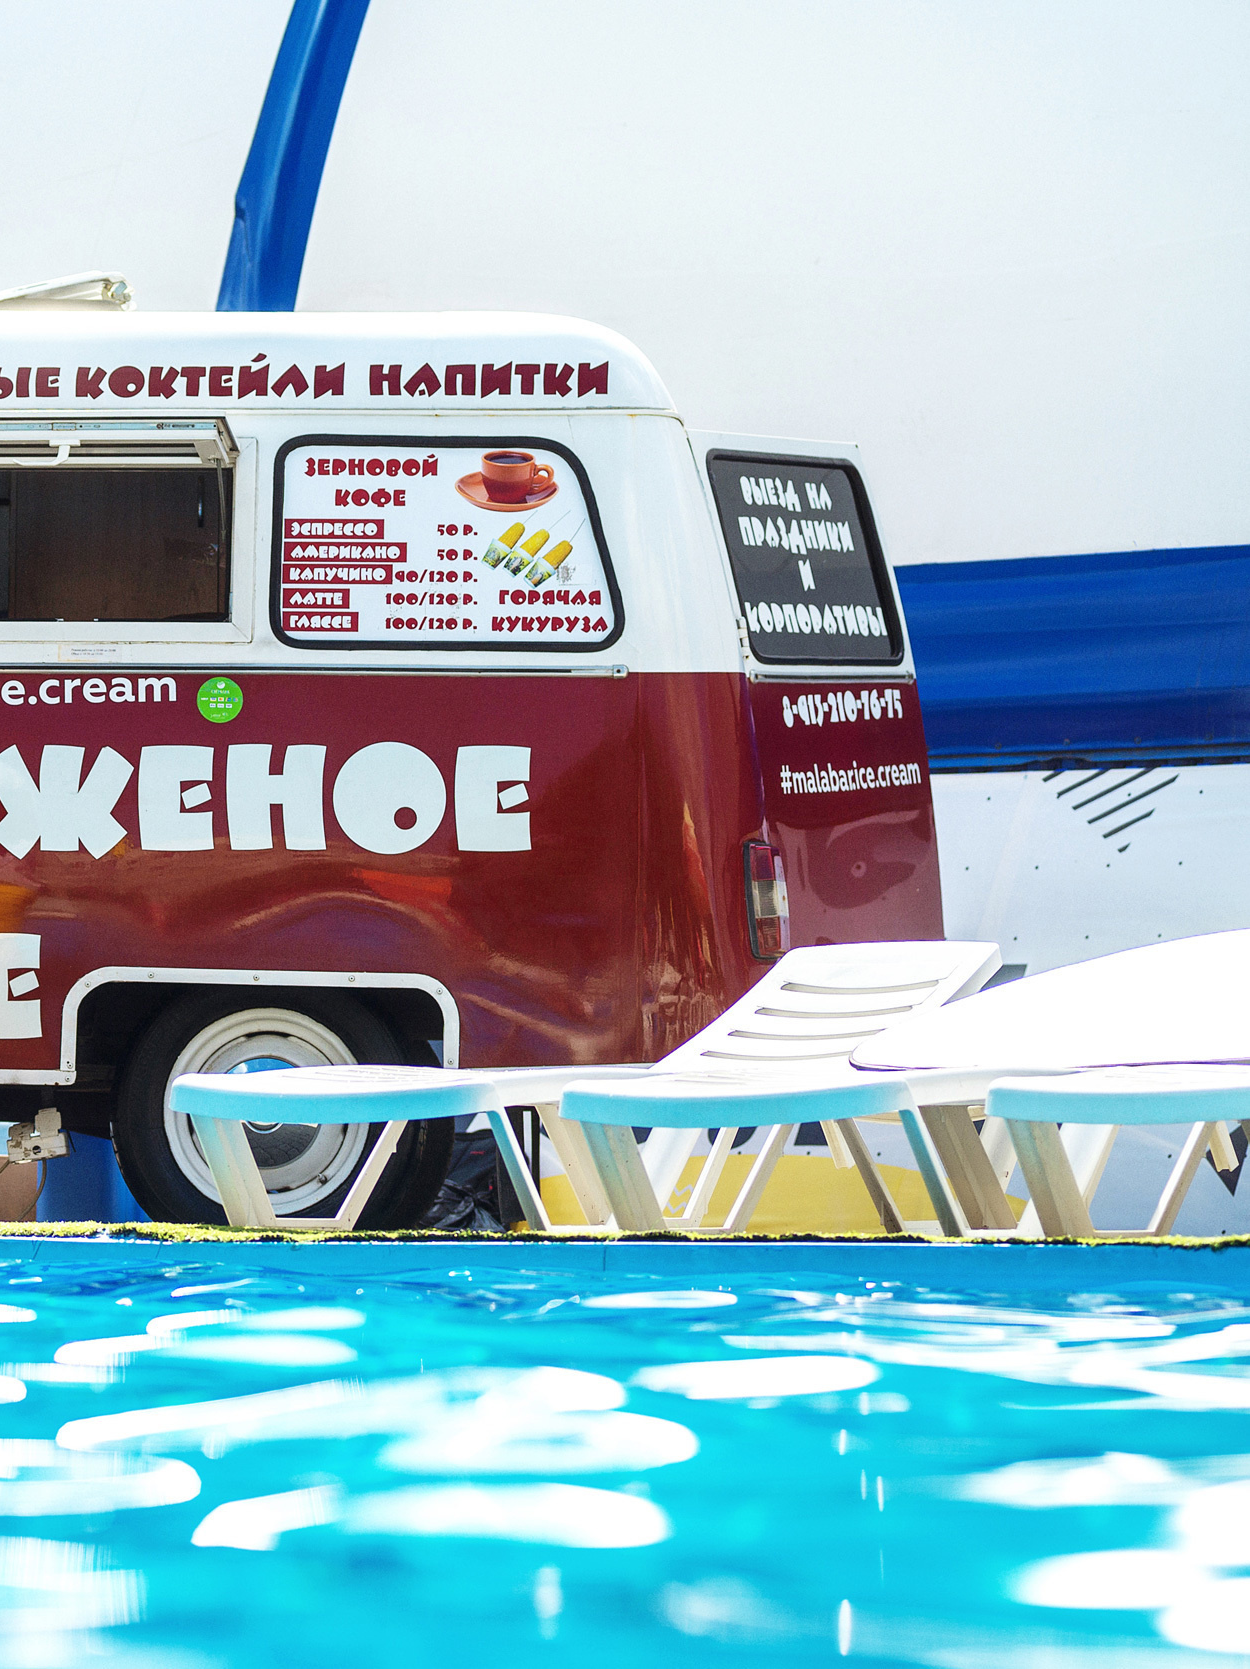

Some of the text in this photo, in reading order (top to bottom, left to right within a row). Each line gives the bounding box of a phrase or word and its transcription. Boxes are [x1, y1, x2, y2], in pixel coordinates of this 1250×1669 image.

[75, 352, 346, 399] КОКТЕЙЛИ
[369, 360, 610, 399] НАПИТКИ
[304, 454, 438, 477] ЗЕРНОВОЙ
[335, 488, 406, 507] КОФЕ
[739, 475, 833, 513] ВЫЕЗД НА
[291, 521, 378, 536] ЭСПРЕССО
[437, 524, 458, 536] 50
[738, 516, 855, 555] ПРАЗДНИКИ
[290, 545, 401, 559] АМЕРИКАНО
[437, 549, 458, 560] 50
[290, 567, 387, 581] КАПУЧИНО
[395, 569, 458, 583] 90/120
[798, 558, 816, 592] И
[290, 591, 343, 605] ЛАТТЕ
[385, 592, 458, 606] 100/120
[499, 589, 601, 606] ГОРЯЧАЯ
[290, 614, 352, 629] ГЛЯССЕ
[385, 616, 457, 630] 100/120
[491, 616, 608, 633] КУКУРУЗА
[744, 601, 888, 637] КОРПОРАТИВЫ
[780, 760, 922, 795] #malabar.ice.cream
